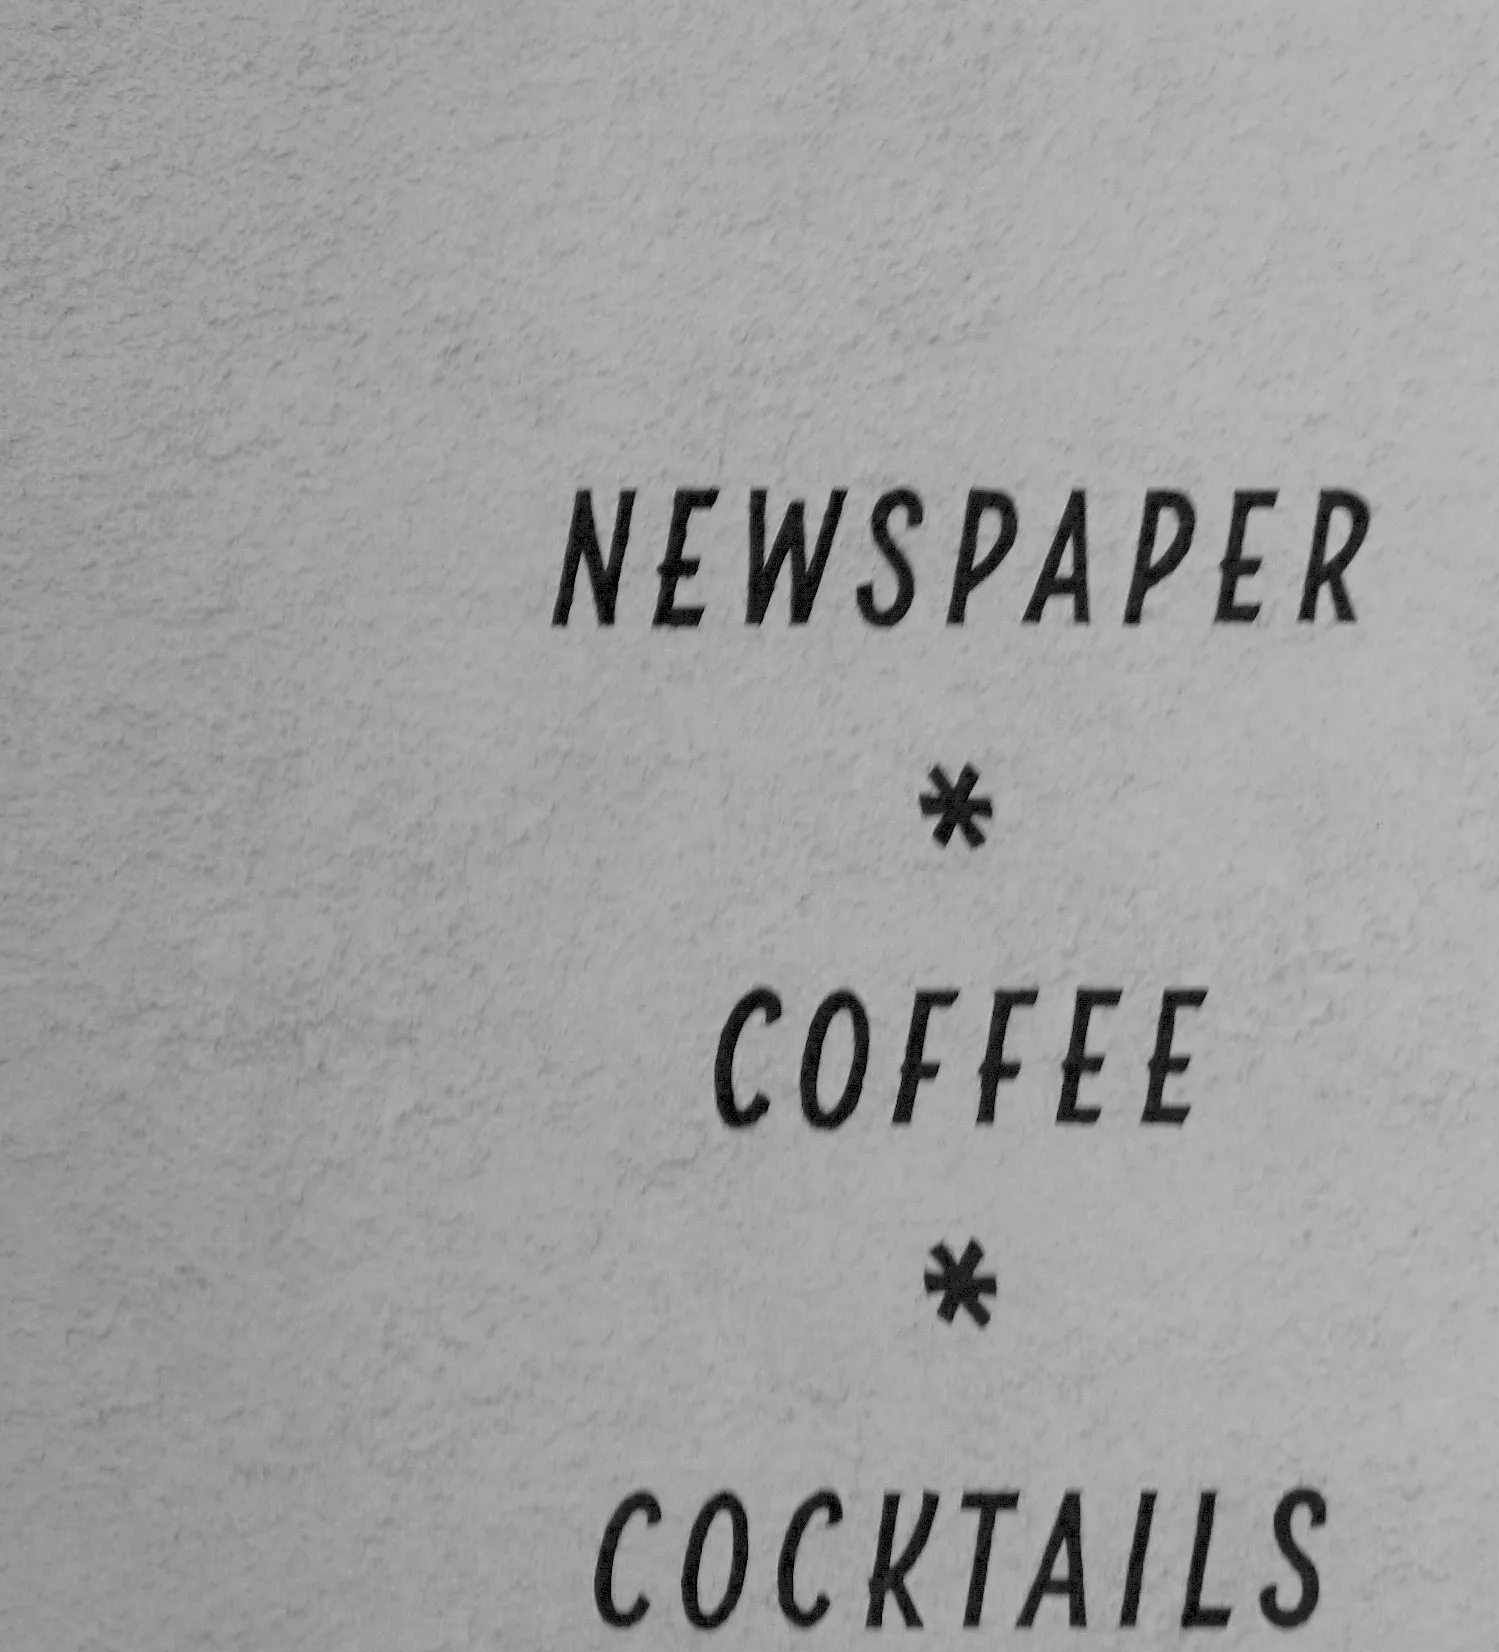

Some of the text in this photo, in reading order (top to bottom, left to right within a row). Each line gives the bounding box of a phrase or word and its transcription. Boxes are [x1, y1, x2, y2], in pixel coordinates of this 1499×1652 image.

[552, 488, 1370, 628] NEWSPAPER
[714, 988, 1208, 1131] COFFEE
[594, 1488, 1327, 1631] COCKTAILS
